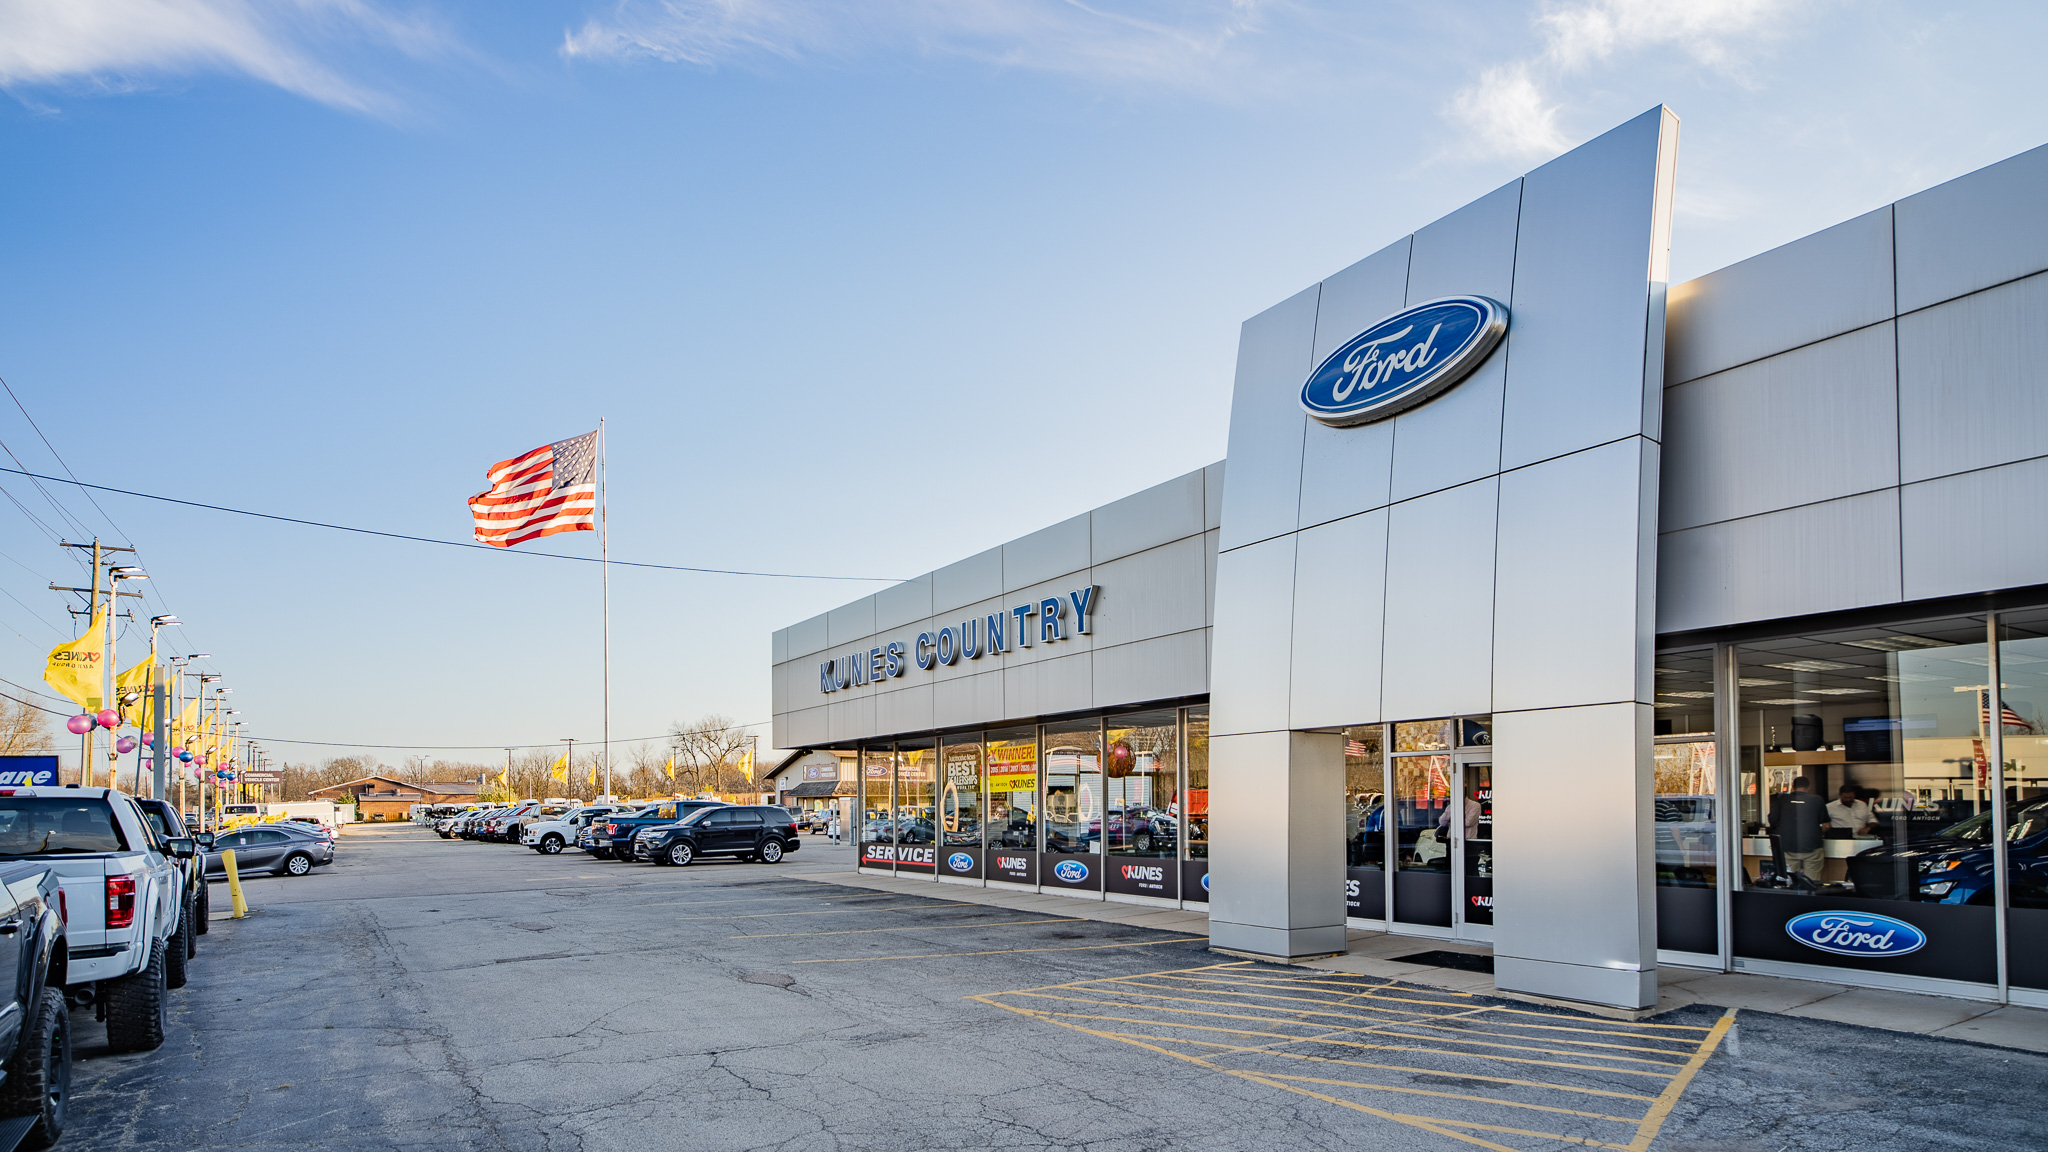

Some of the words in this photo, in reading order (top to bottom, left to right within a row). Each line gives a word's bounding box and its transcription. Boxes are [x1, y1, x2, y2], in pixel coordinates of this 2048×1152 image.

[1332, 322, 1443, 402] Ford
[819, 640, 905, 694] KUNES
[915, 585, 1100, 671] COUNTRY
[997, 745, 1036, 761] WINNER!
[947, 760, 977, 777] BEST
[1013, 778, 1036, 789] KUNES
[866, 845, 935, 863] SERVICE
[952, 854, 969, 869] Ford
[1001, 856, 1027, 870] KUNES
[1060, 863, 1082, 879] Ford
[1127, 865, 1163, 881] KUNES
[1812, 916, 1896, 950] Ford
